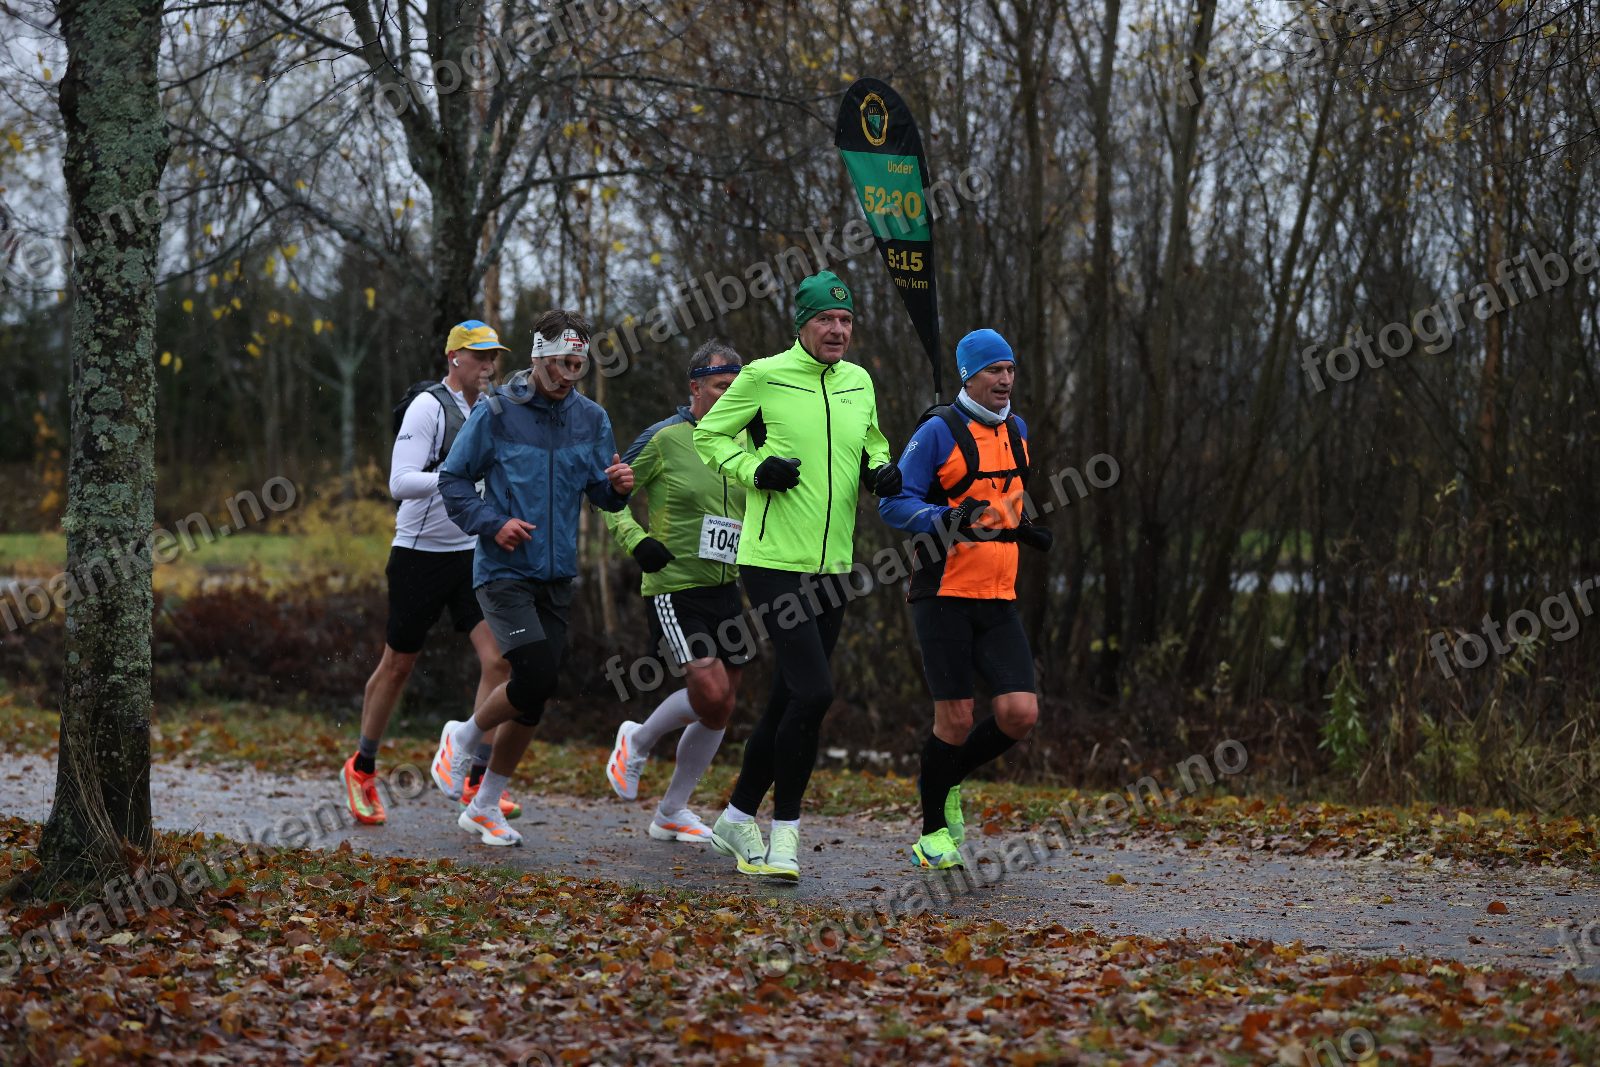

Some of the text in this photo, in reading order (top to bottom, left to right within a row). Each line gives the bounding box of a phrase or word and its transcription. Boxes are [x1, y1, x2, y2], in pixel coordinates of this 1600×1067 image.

[887, 160, 913, 174] Under
[864, 185, 922, 219] 52:30
[887, 248, 924, 272] 5:15
[894, 275, 929, 289] min/km
